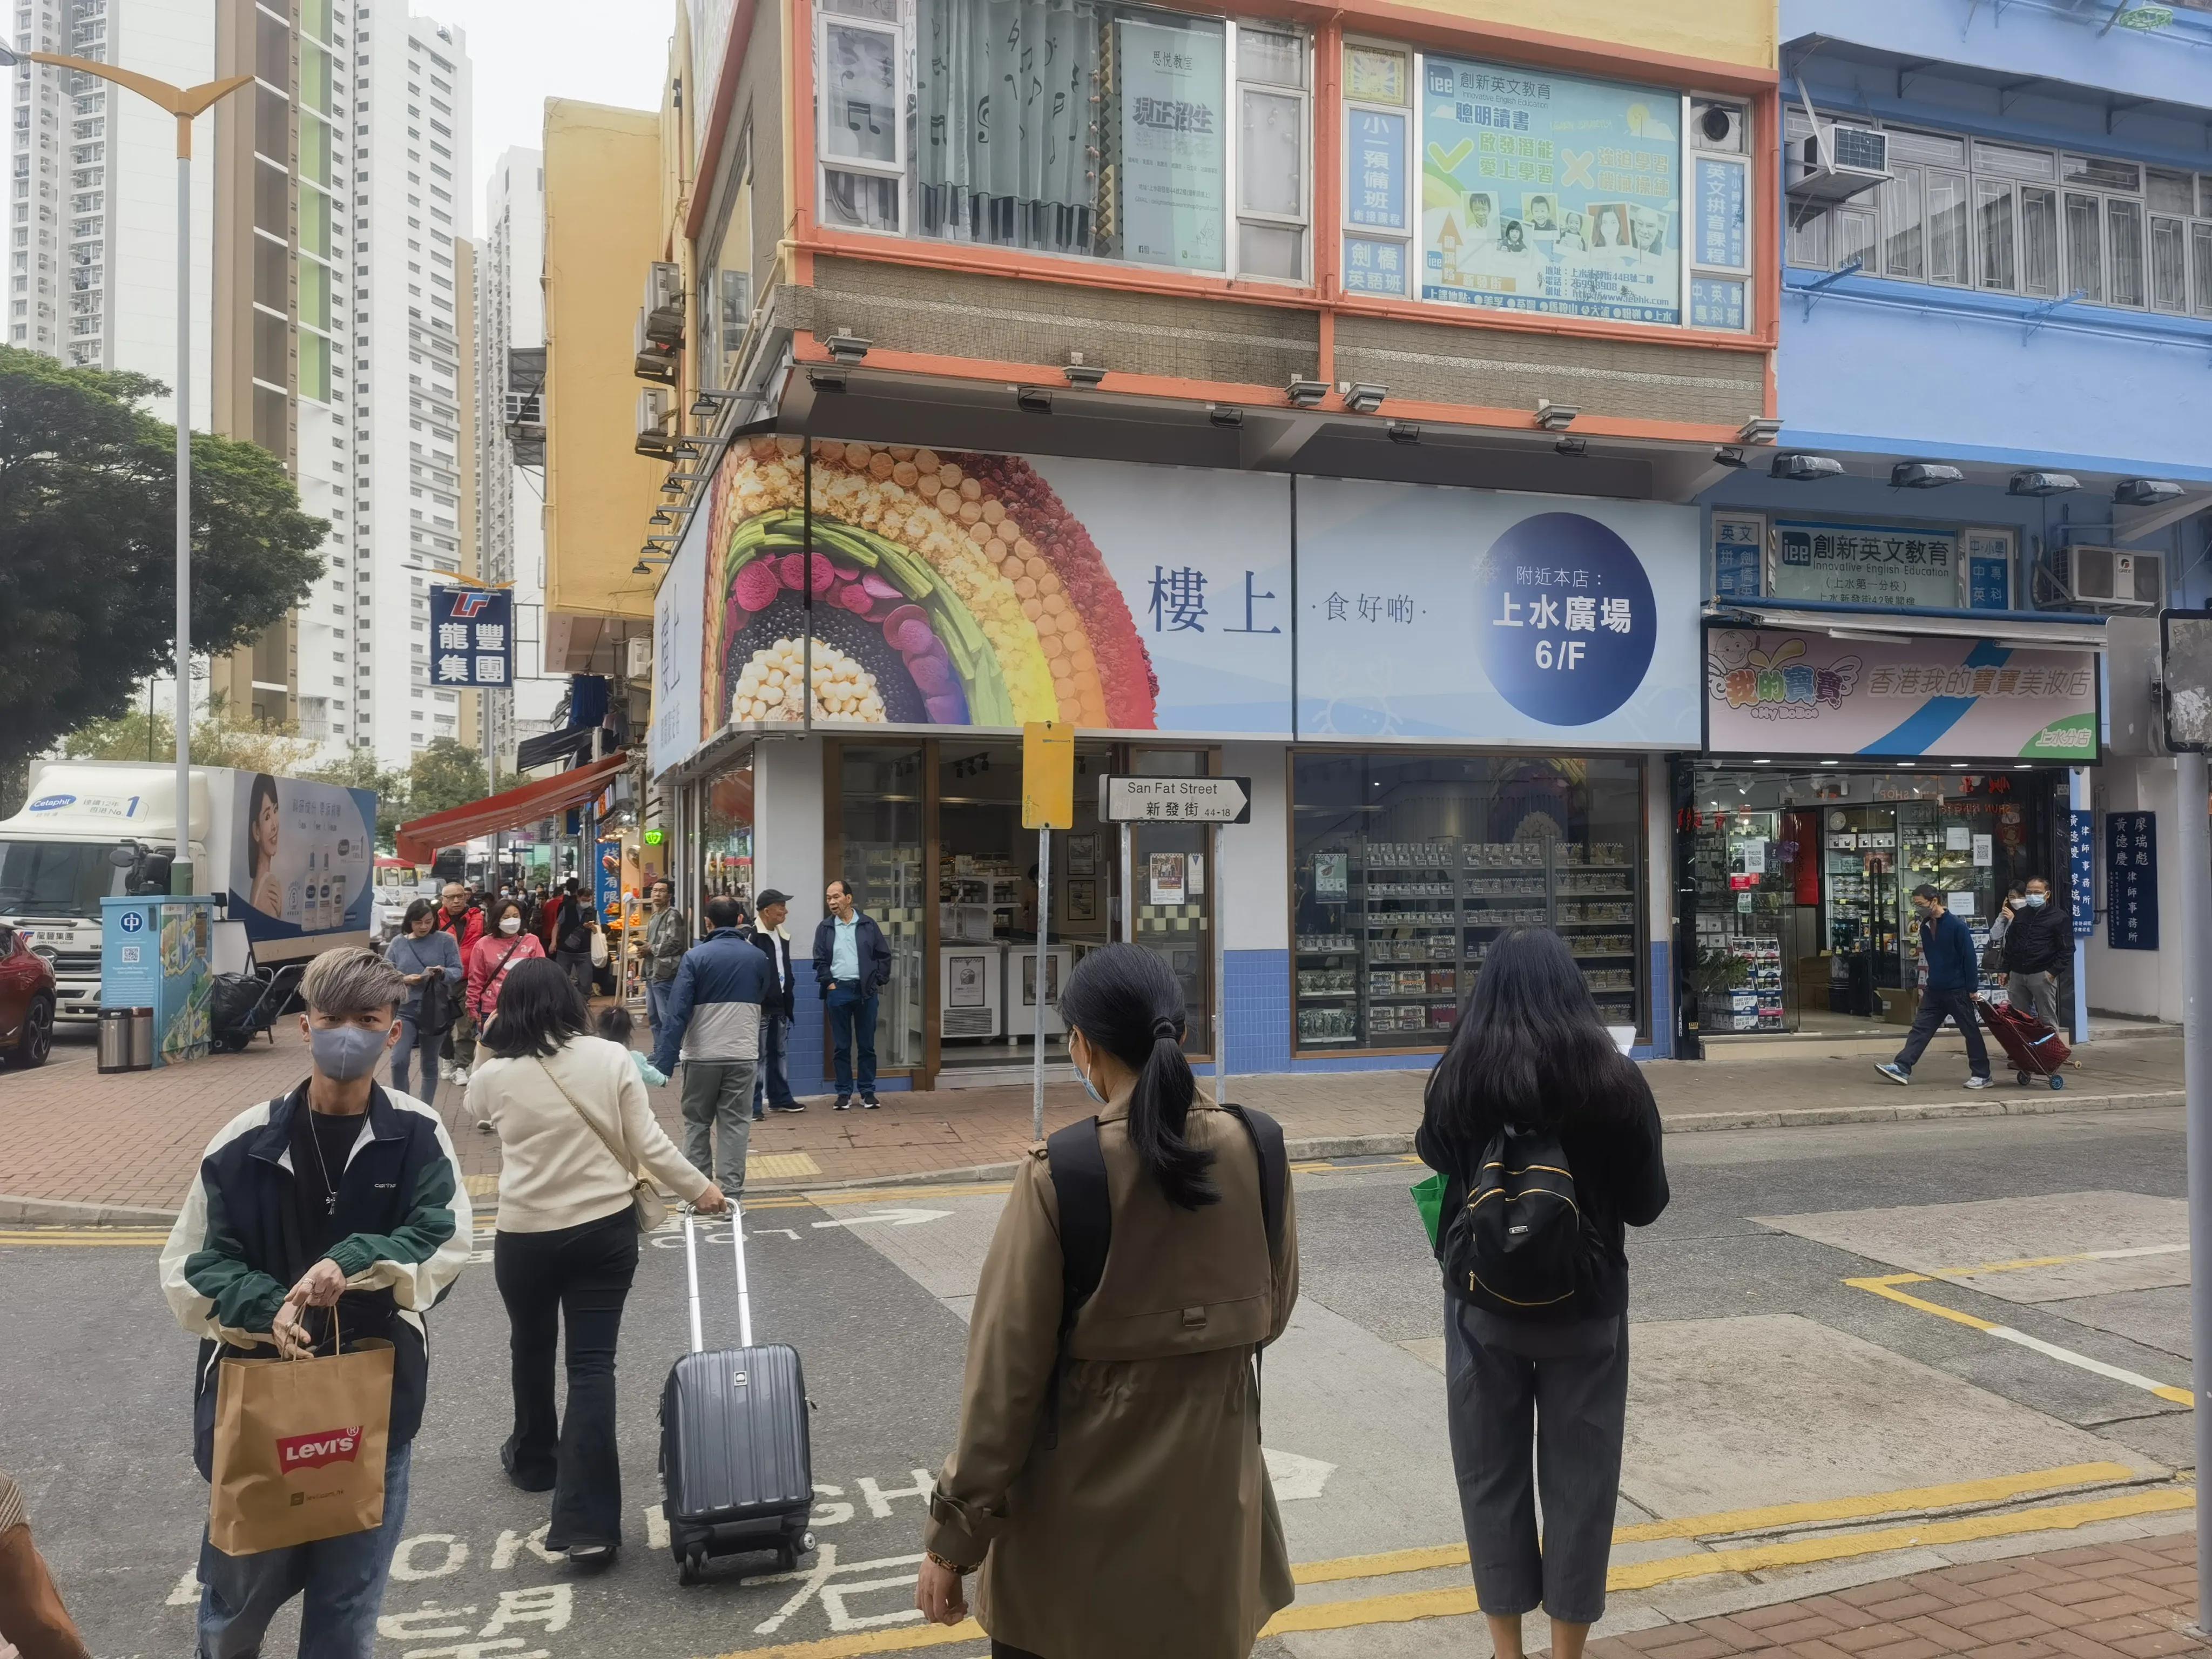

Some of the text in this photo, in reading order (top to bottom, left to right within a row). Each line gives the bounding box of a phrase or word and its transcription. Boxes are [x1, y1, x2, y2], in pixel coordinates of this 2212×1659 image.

[1460, 72, 1550, 100] 創新英文教育
[1462, 92, 1549, 109] Innovative English Education
[1455, 102, 1530, 132] 聰明讀書
[1363, 116, 1390, 210] 小一預備班
[1479, 157, 1554, 184] 愛上學習
[1706, 164, 1726, 265] 英文拼音課程
[1351, 242, 1398, 271] 劍橋
[1348, 269, 1401, 292] 英語班
[1695, 305, 1739, 325] 專科班
[1721, 524, 1752, 542] 英文
[1784, 539, 1809, 562] iee
[1813, 533, 1949, 567] 創新英文教育
[1813, 560, 1950, 577] Innovative English Education
[1147, 565, 1282, 634] 樓上
[1492, 592, 1631, 634] 上水廣場
[439, 622, 505, 651] 龍豐
[438, 653, 505, 683] 集團
[1535, 640, 1586, 670] 6/F
[1725, 664, 1843, 708] 我的寶寶
[2036, 728, 2092, 747] 上水分店
[1128, 782, 1217, 794] San Fat Street
[33, 798, 71, 807] Cetaphil
[125, 795, 140, 818] 1
[1146, 801, 1231, 817] 新發街 44-18
[2114, 817, 2128, 867] 黃德慶
[2134, 817, 2149, 866] 廖瑞彪
[2081, 825, 2091, 906] 律師事務所
[2127, 871, 2139, 943] 律師事務所
[36, 931, 74, 941] 龍豐集團
[286, 1437, 354, 1461] Levi's
